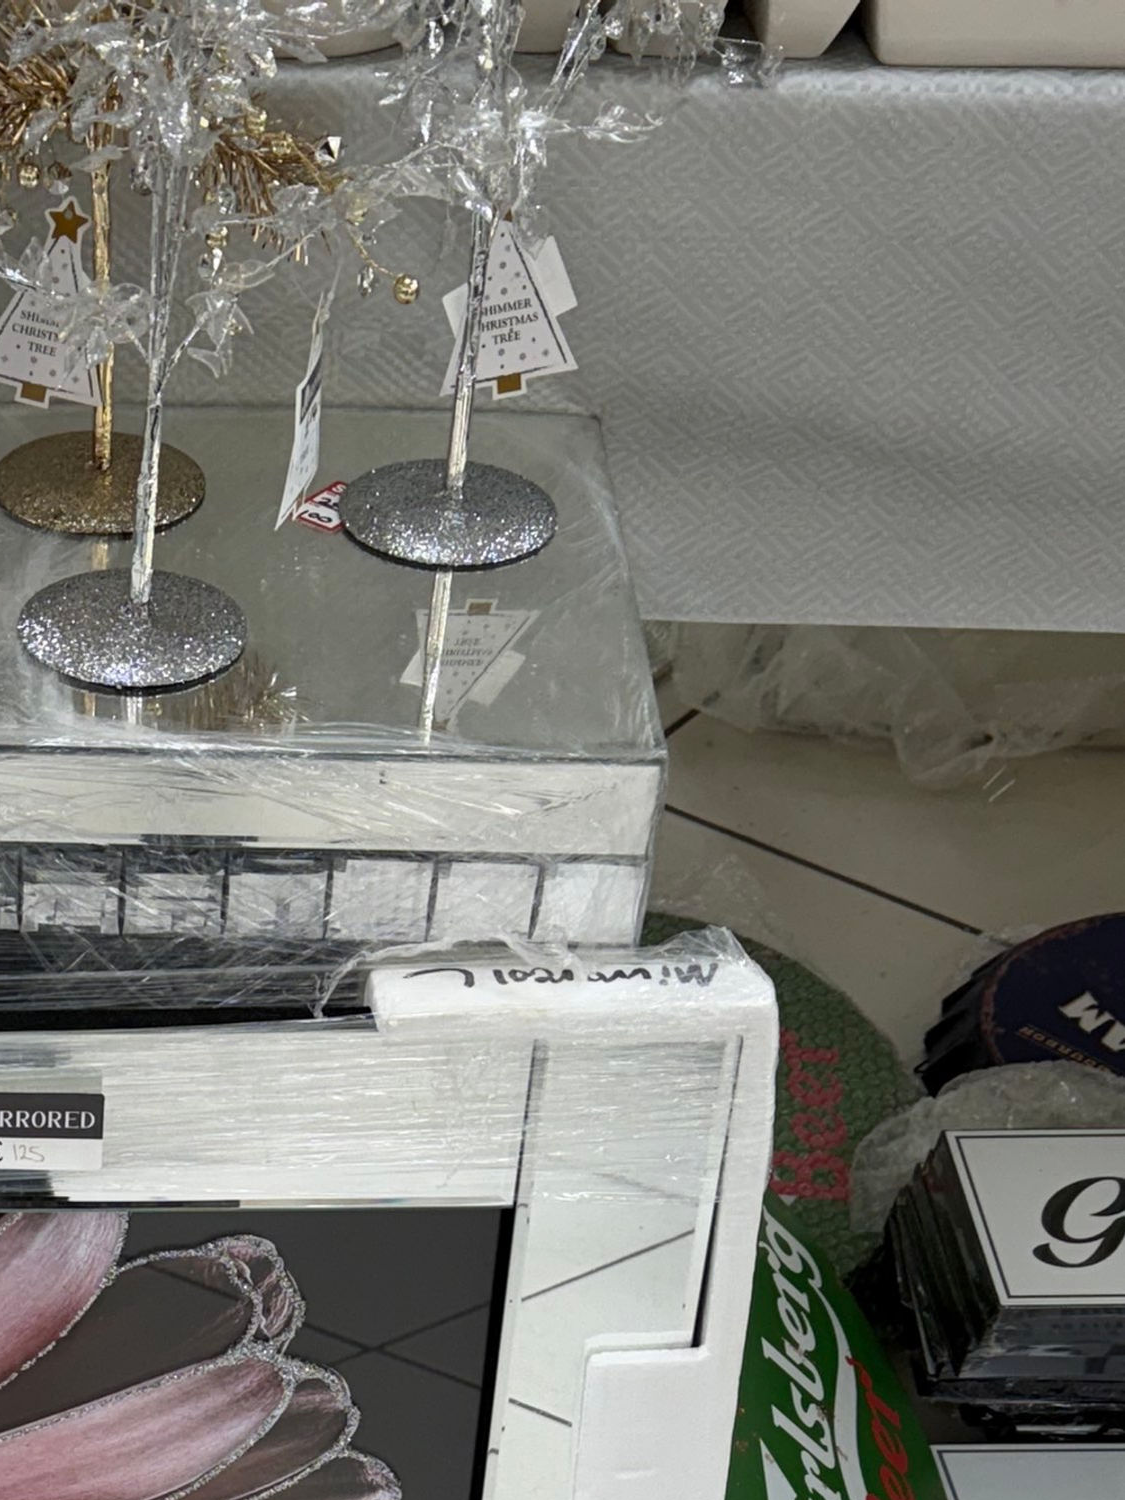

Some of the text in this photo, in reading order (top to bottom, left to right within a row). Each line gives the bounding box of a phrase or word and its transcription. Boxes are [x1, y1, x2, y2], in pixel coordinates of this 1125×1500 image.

[479, 297, 532, 317] HIMMER
[480, 311, 539, 332] HRISTMAS
[492, 330, 522, 345] TREE
[27, 340, 57, 357] TREE
